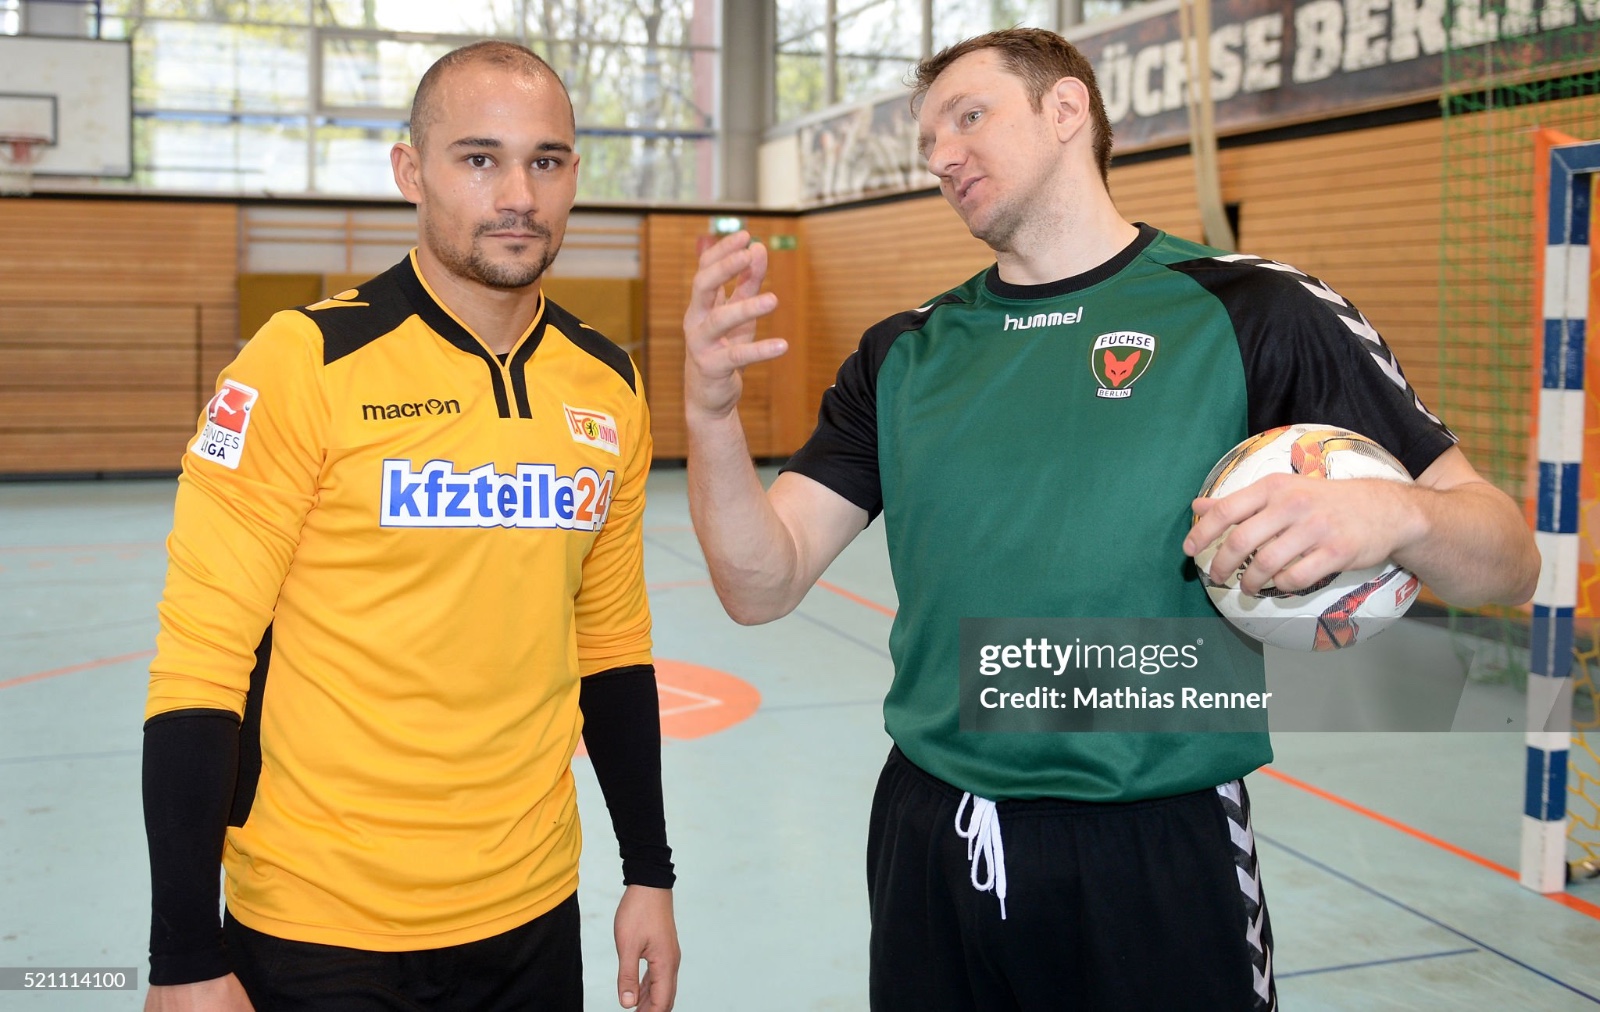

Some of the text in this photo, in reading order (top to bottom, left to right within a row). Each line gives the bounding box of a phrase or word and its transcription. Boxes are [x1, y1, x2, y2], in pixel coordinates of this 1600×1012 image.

[1098, 13, 1283, 124] ÜCHSE
[1003, 306, 1084, 331] hummel
[1100, 334, 1151, 347] FÜCHSE
[362, 398, 461, 420] macron
[389, 470, 611, 521] kfzteile24
